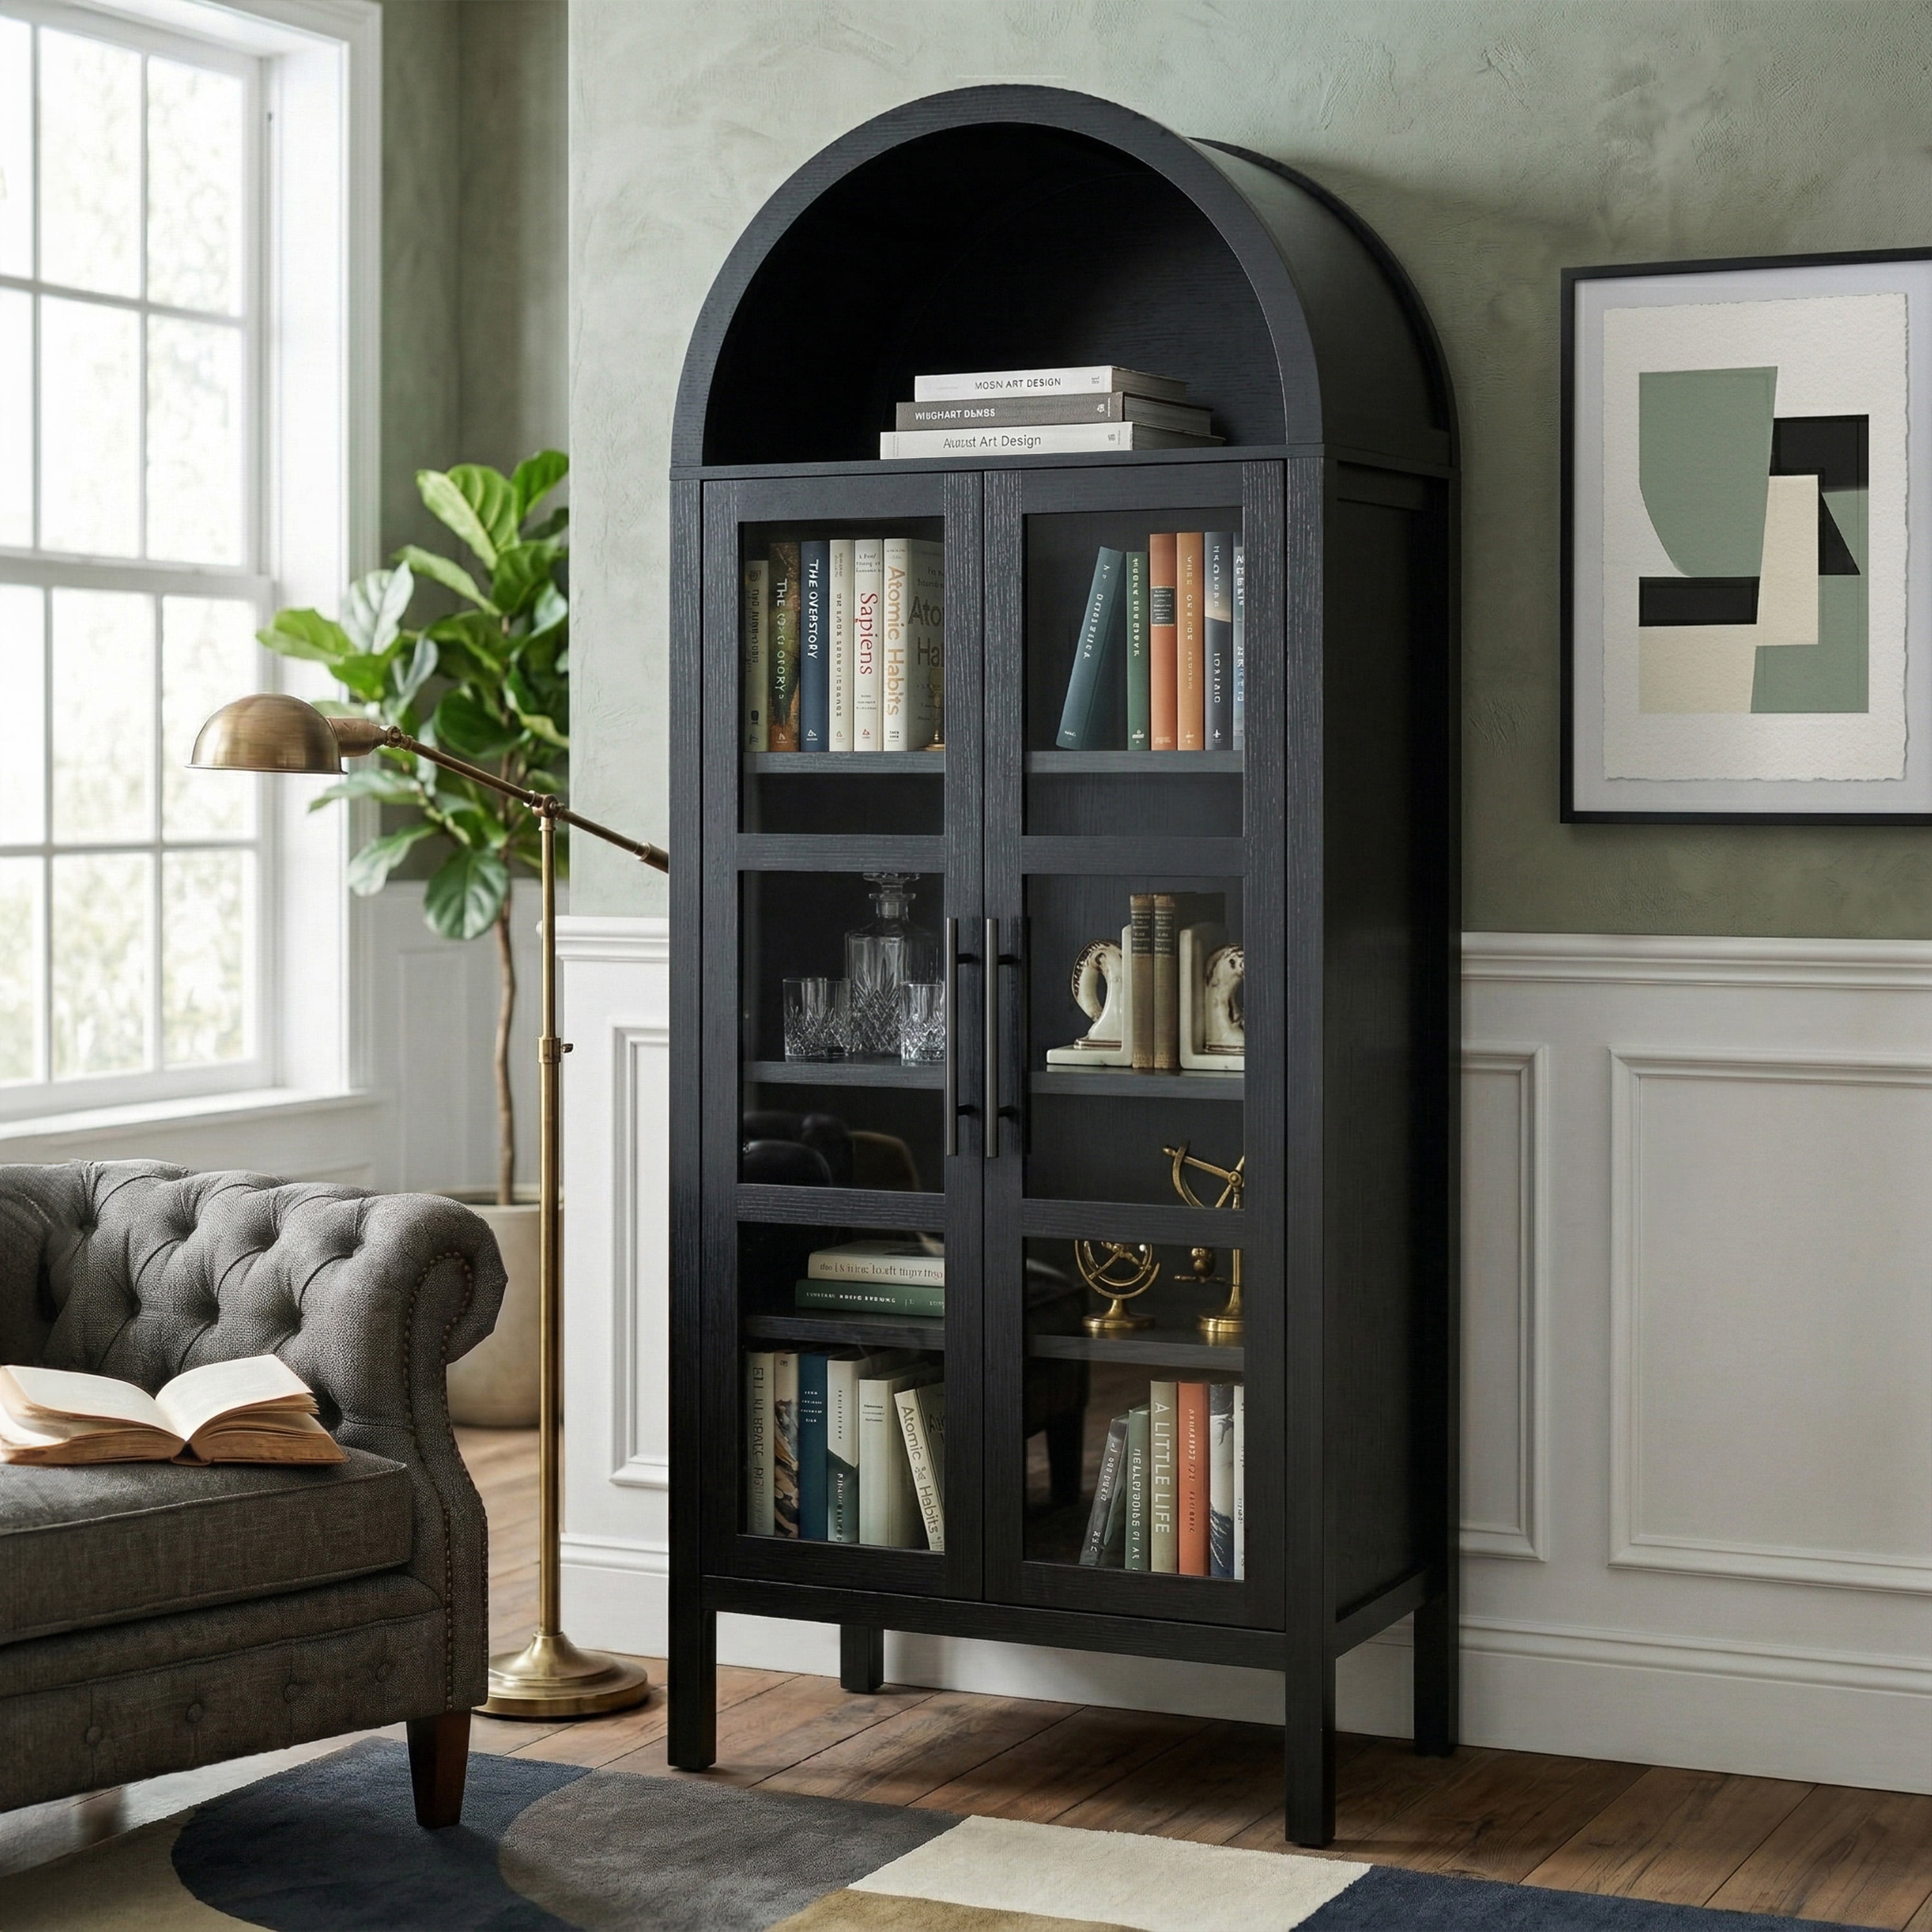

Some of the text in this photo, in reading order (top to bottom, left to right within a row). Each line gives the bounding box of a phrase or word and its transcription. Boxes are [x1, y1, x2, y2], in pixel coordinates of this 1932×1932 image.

[1005, 379, 1023, 388] ART
[1027, 377, 1061, 388] DESIGN
[980, 435, 998, 447] Art
[1001, 434, 1041, 449] Design
[776, 578, 788, 607] THE
[808, 559, 819, 587] THE
[887, 565, 906, 640] Atomic
[908, 595, 944, 627] Ato
[855, 592, 878, 674] Sapiens
[887, 648, 905, 715] Habits
[901, 1405, 938, 1534] Atomic Habits
[1155, 1402, 1170, 1533] A LITTLE LIFE
